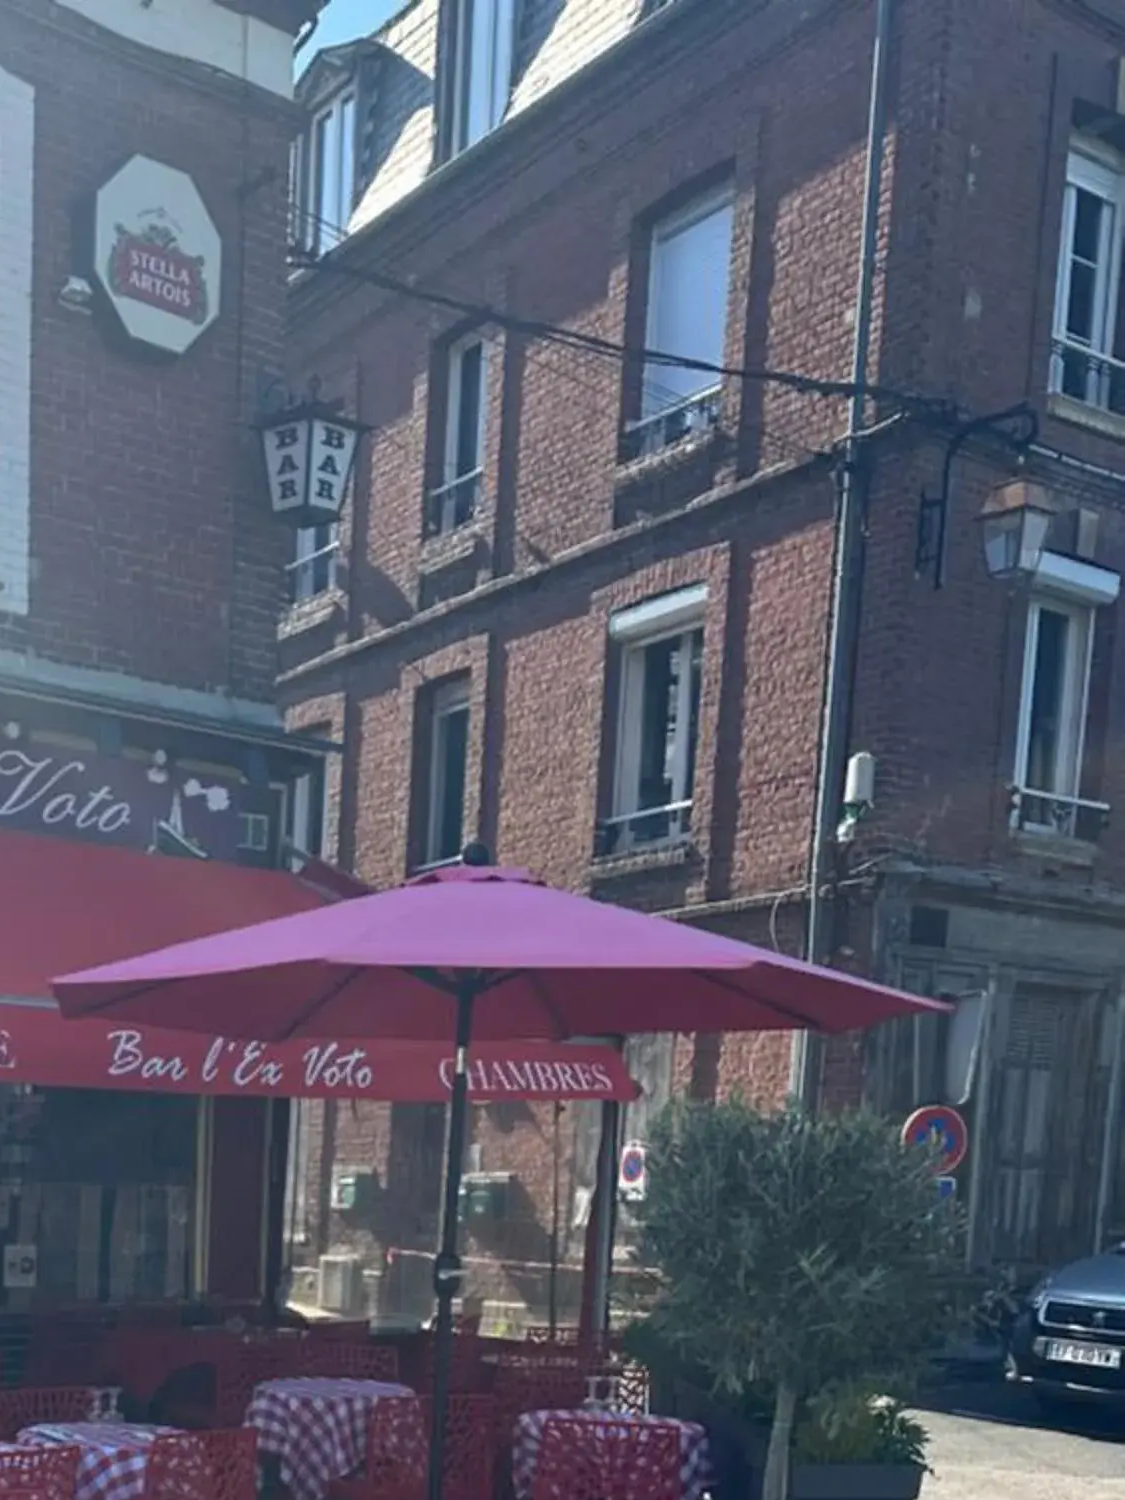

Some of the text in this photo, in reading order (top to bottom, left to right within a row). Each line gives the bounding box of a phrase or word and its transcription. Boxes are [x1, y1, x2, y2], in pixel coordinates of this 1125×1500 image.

[129, 269, 193, 307] ARTOIS
[130, 250, 191, 286] STELLA
[275, 427, 299, 500] BAR
[315, 426, 346, 501] BAR
[107, 1029, 188, 1081] Bar
[202, 1036, 284, 1086] l'Ex
[303, 1041, 372, 1088] Voto
